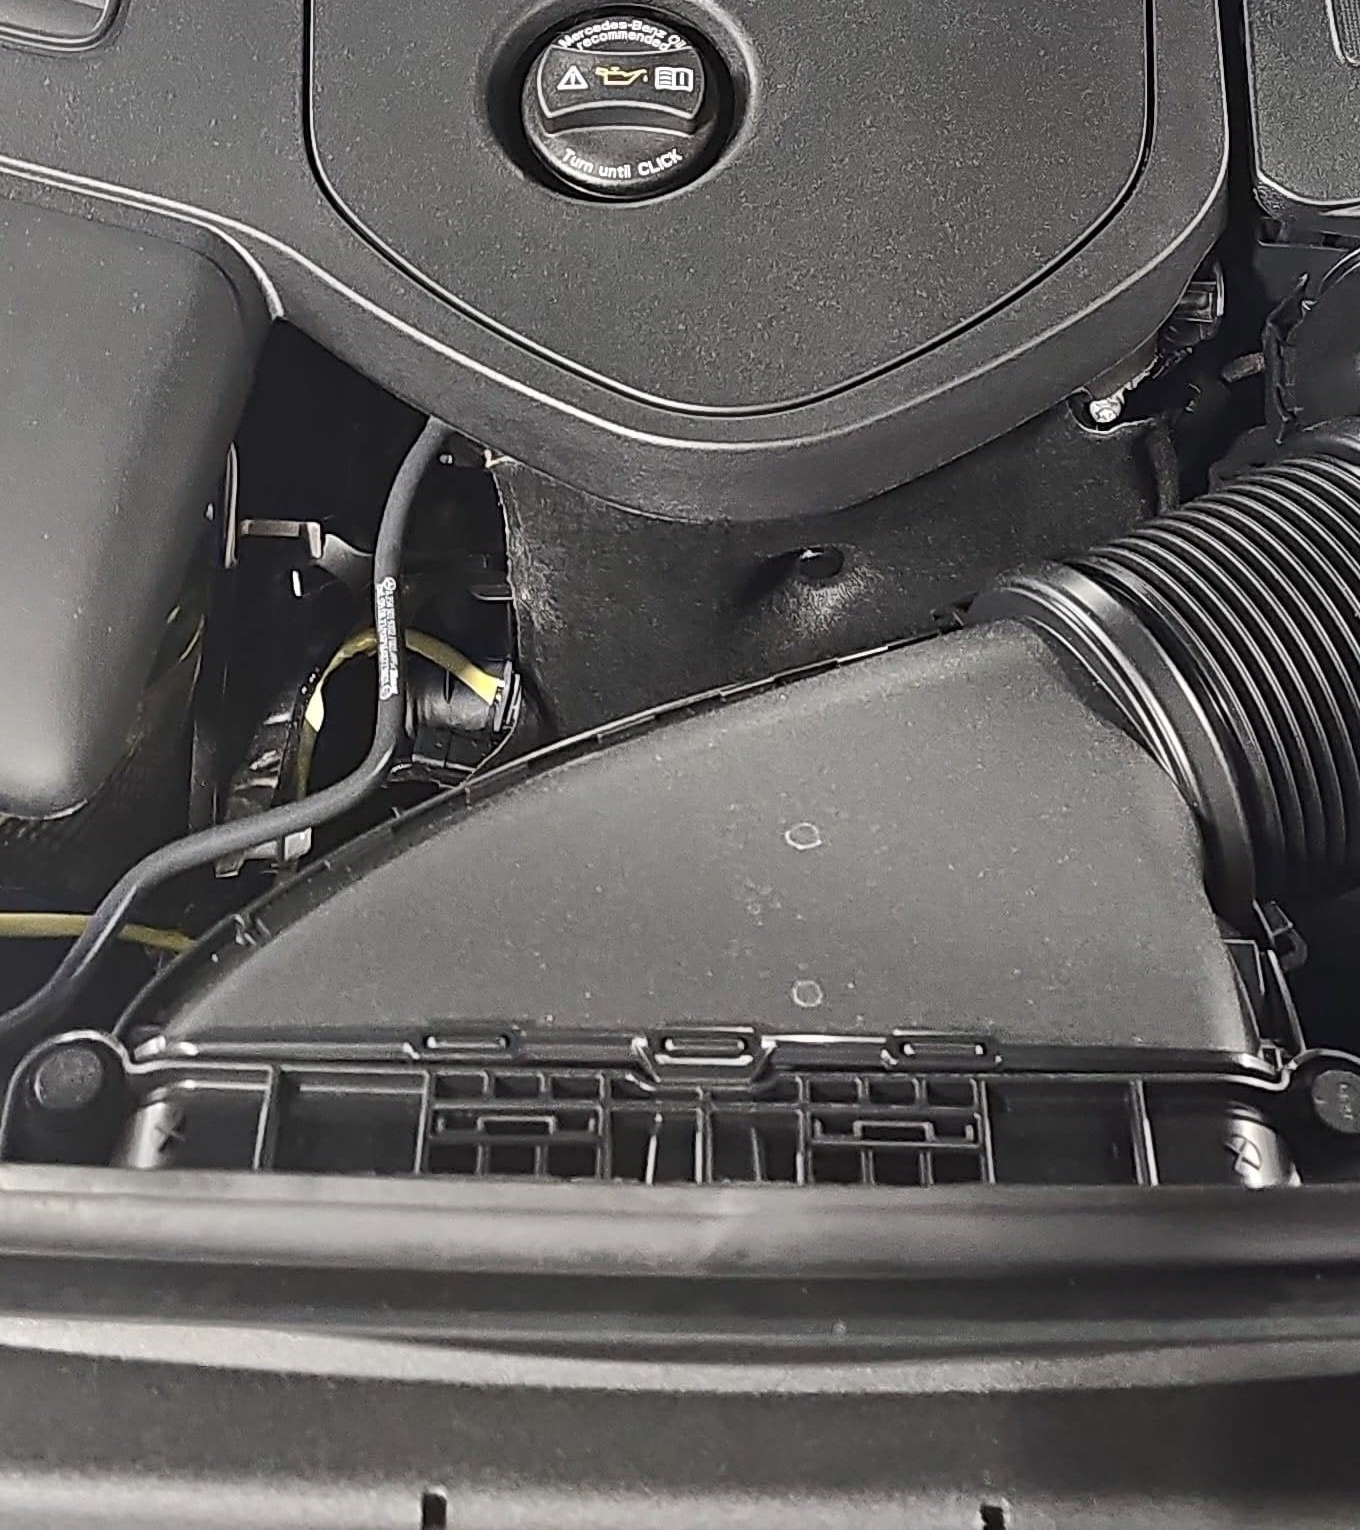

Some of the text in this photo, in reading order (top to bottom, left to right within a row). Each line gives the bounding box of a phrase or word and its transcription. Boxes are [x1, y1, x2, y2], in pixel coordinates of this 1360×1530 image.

[558, 20, 667, 50] Mercedes-Benz
[576, 30, 671, 51] recommended
[562, 148, 683, 180] Turn until CLICK
